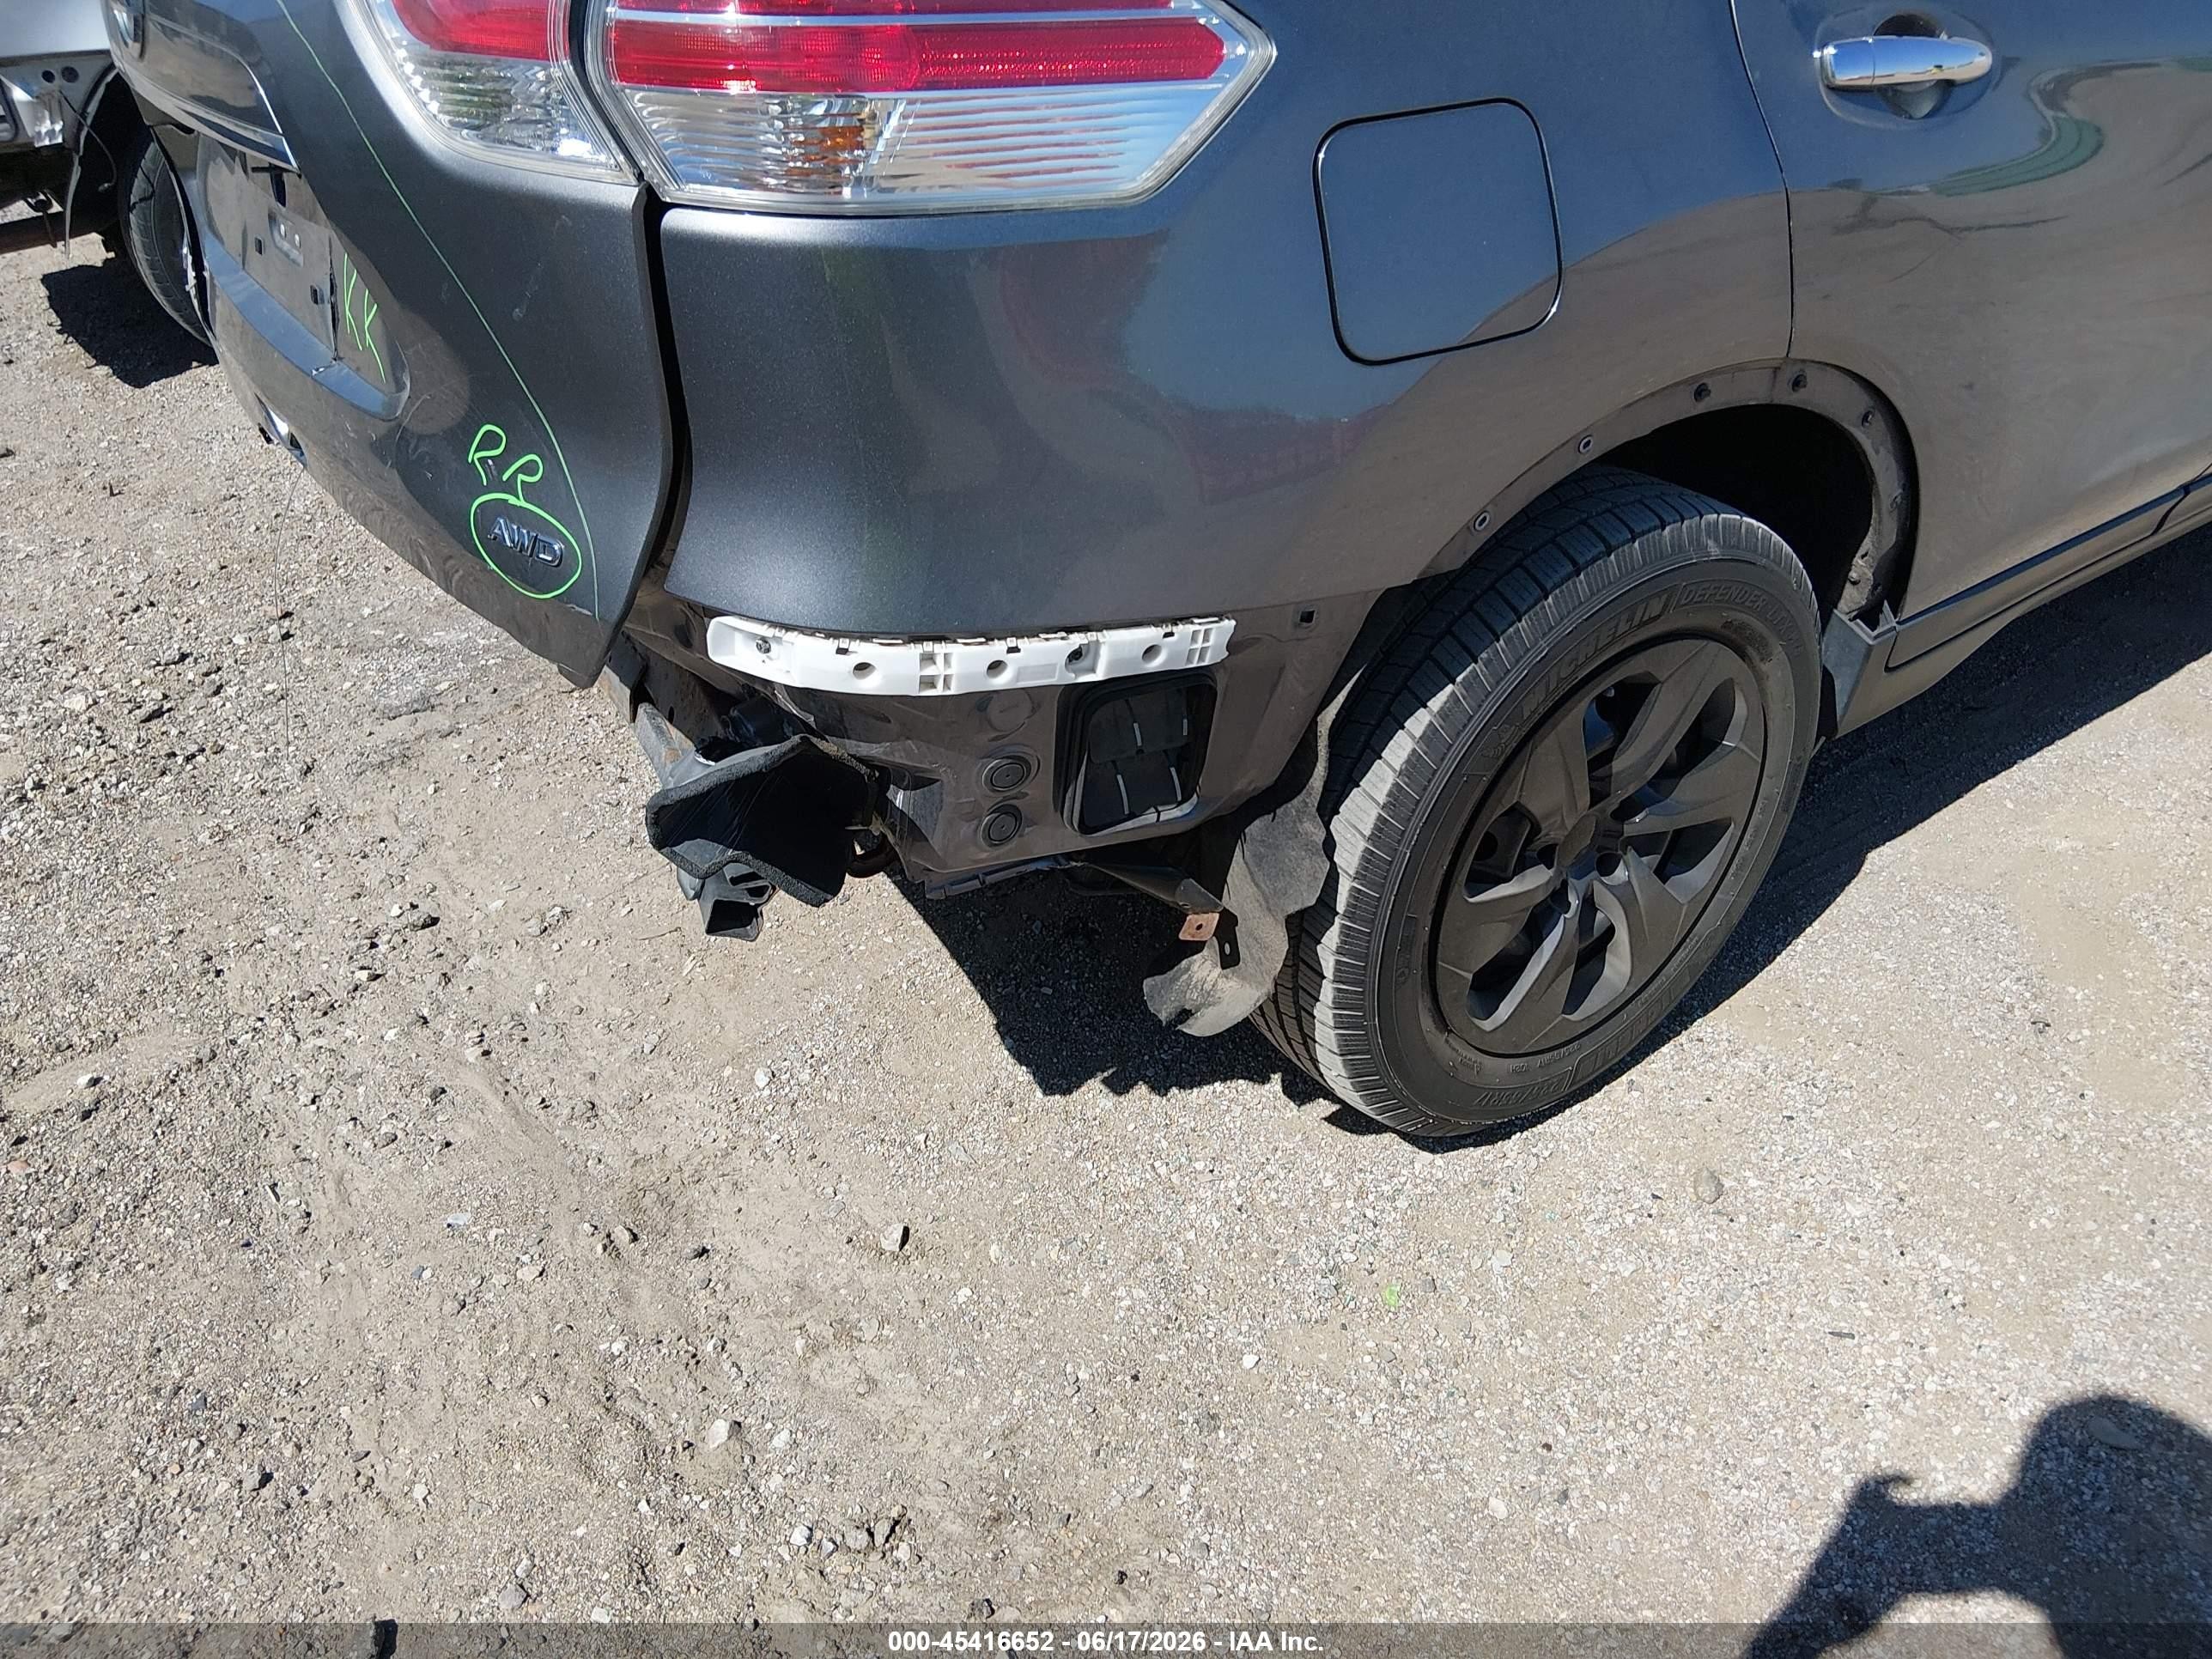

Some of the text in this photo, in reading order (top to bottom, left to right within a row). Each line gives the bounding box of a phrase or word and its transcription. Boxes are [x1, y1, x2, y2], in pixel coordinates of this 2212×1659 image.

[487, 516, 565, 568] AWD
[1680, 584, 1766, 611] DEFENDER
[1522, 591, 1673, 722] MICHELIN
